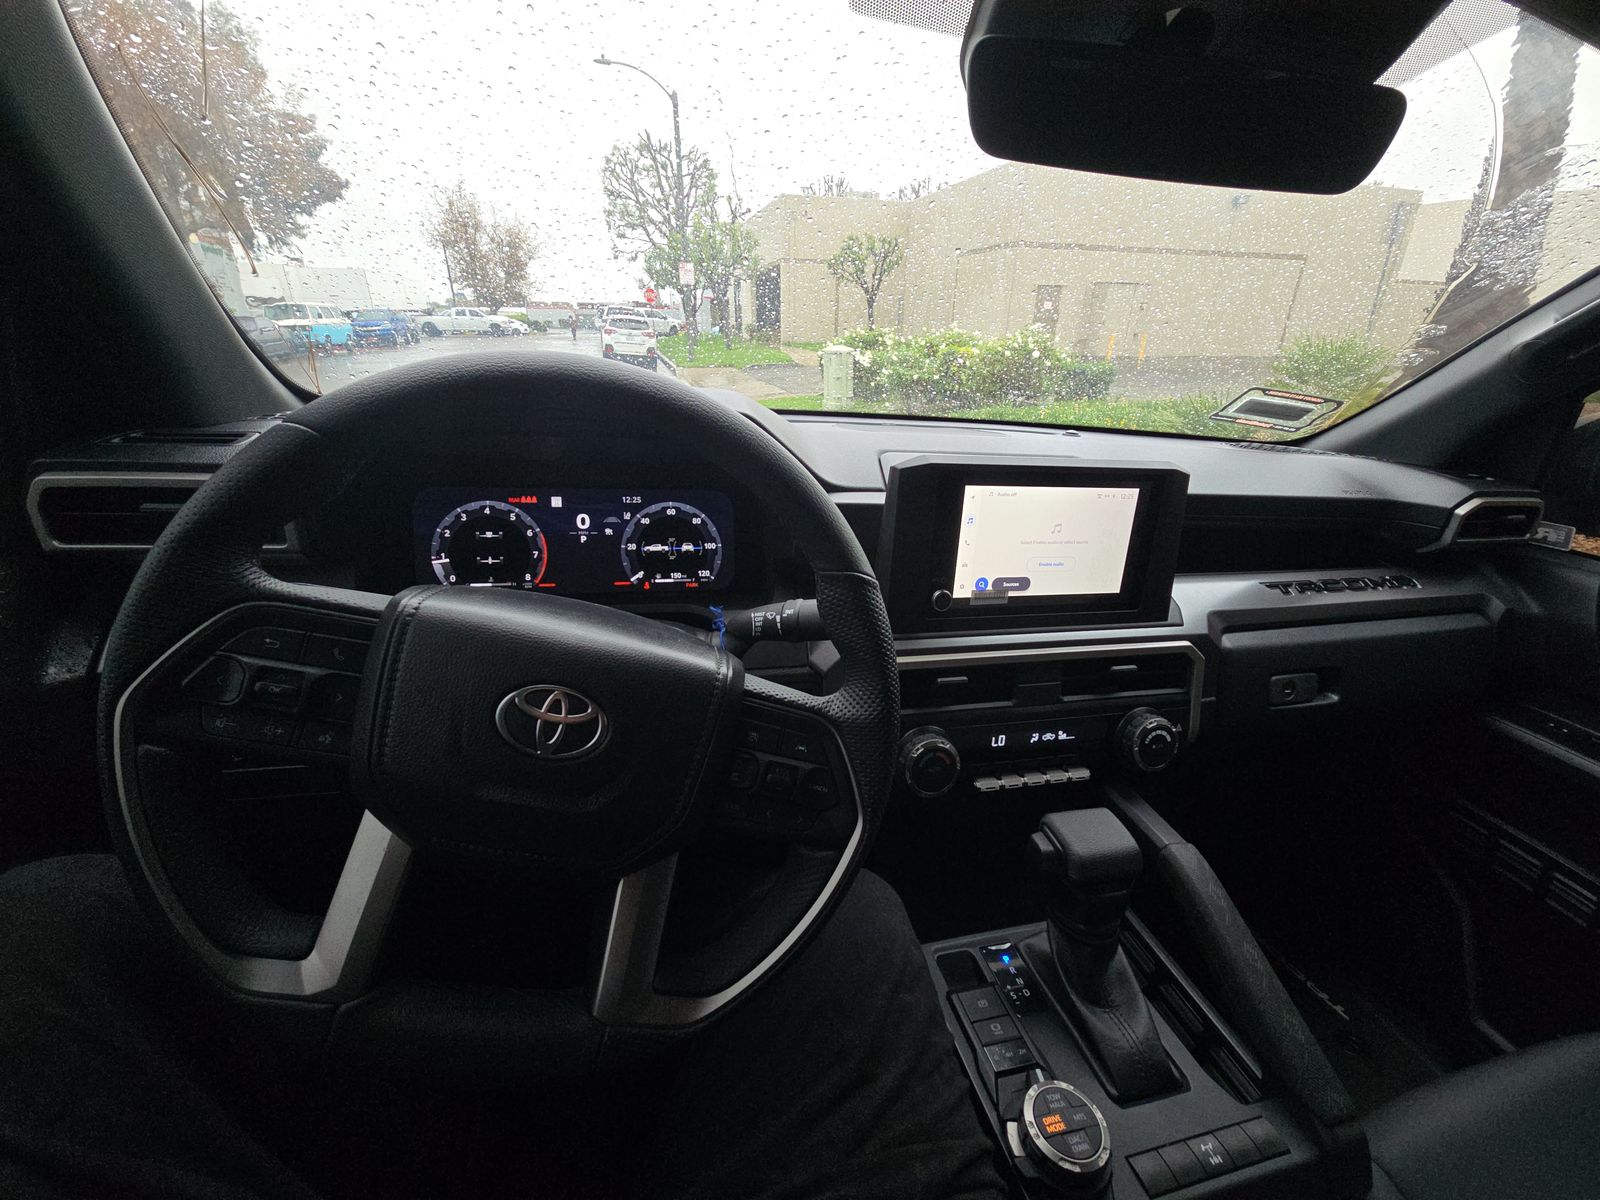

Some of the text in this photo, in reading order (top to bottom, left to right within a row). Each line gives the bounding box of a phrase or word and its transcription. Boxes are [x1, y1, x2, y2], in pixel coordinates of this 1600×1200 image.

[622, 496, 642, 504] 12:25
[484, 507, 490, 515] 4
[666, 508, 676, 516] 60
[460, 512, 467, 521] 3
[510, 512, 516, 521] 5
[576, 513, 591, 529] 0
[640, 517, 650, 525] 40
[692, 517, 702, 525] 80
[444, 529, 451, 537] 2
[526, 529, 533, 537] 6
[580, 535, 588, 544] P
[627, 543, 637, 551] 20
[704, 542, 717, 550] 100
[440, 552, 446, 560] 1
[532, 551, 539, 559] 7
[449, 575, 456, 583] 0
[525, 573, 532, 581] 8
[1258, 575, 1422, 596] TACOMA
[991, 735, 1006, 747] LO
[1002, 955, 1009, 964] P
[1009, 966, 1017, 975] R
[1016, 978, 1024, 986] N
[1010, 991, 1017, 1000] S
[1023, 988, 1031, 997] D
[1042, 1114, 1063, 1126] DRIVE
[1045, 1122, 1068, 1134] MODE
